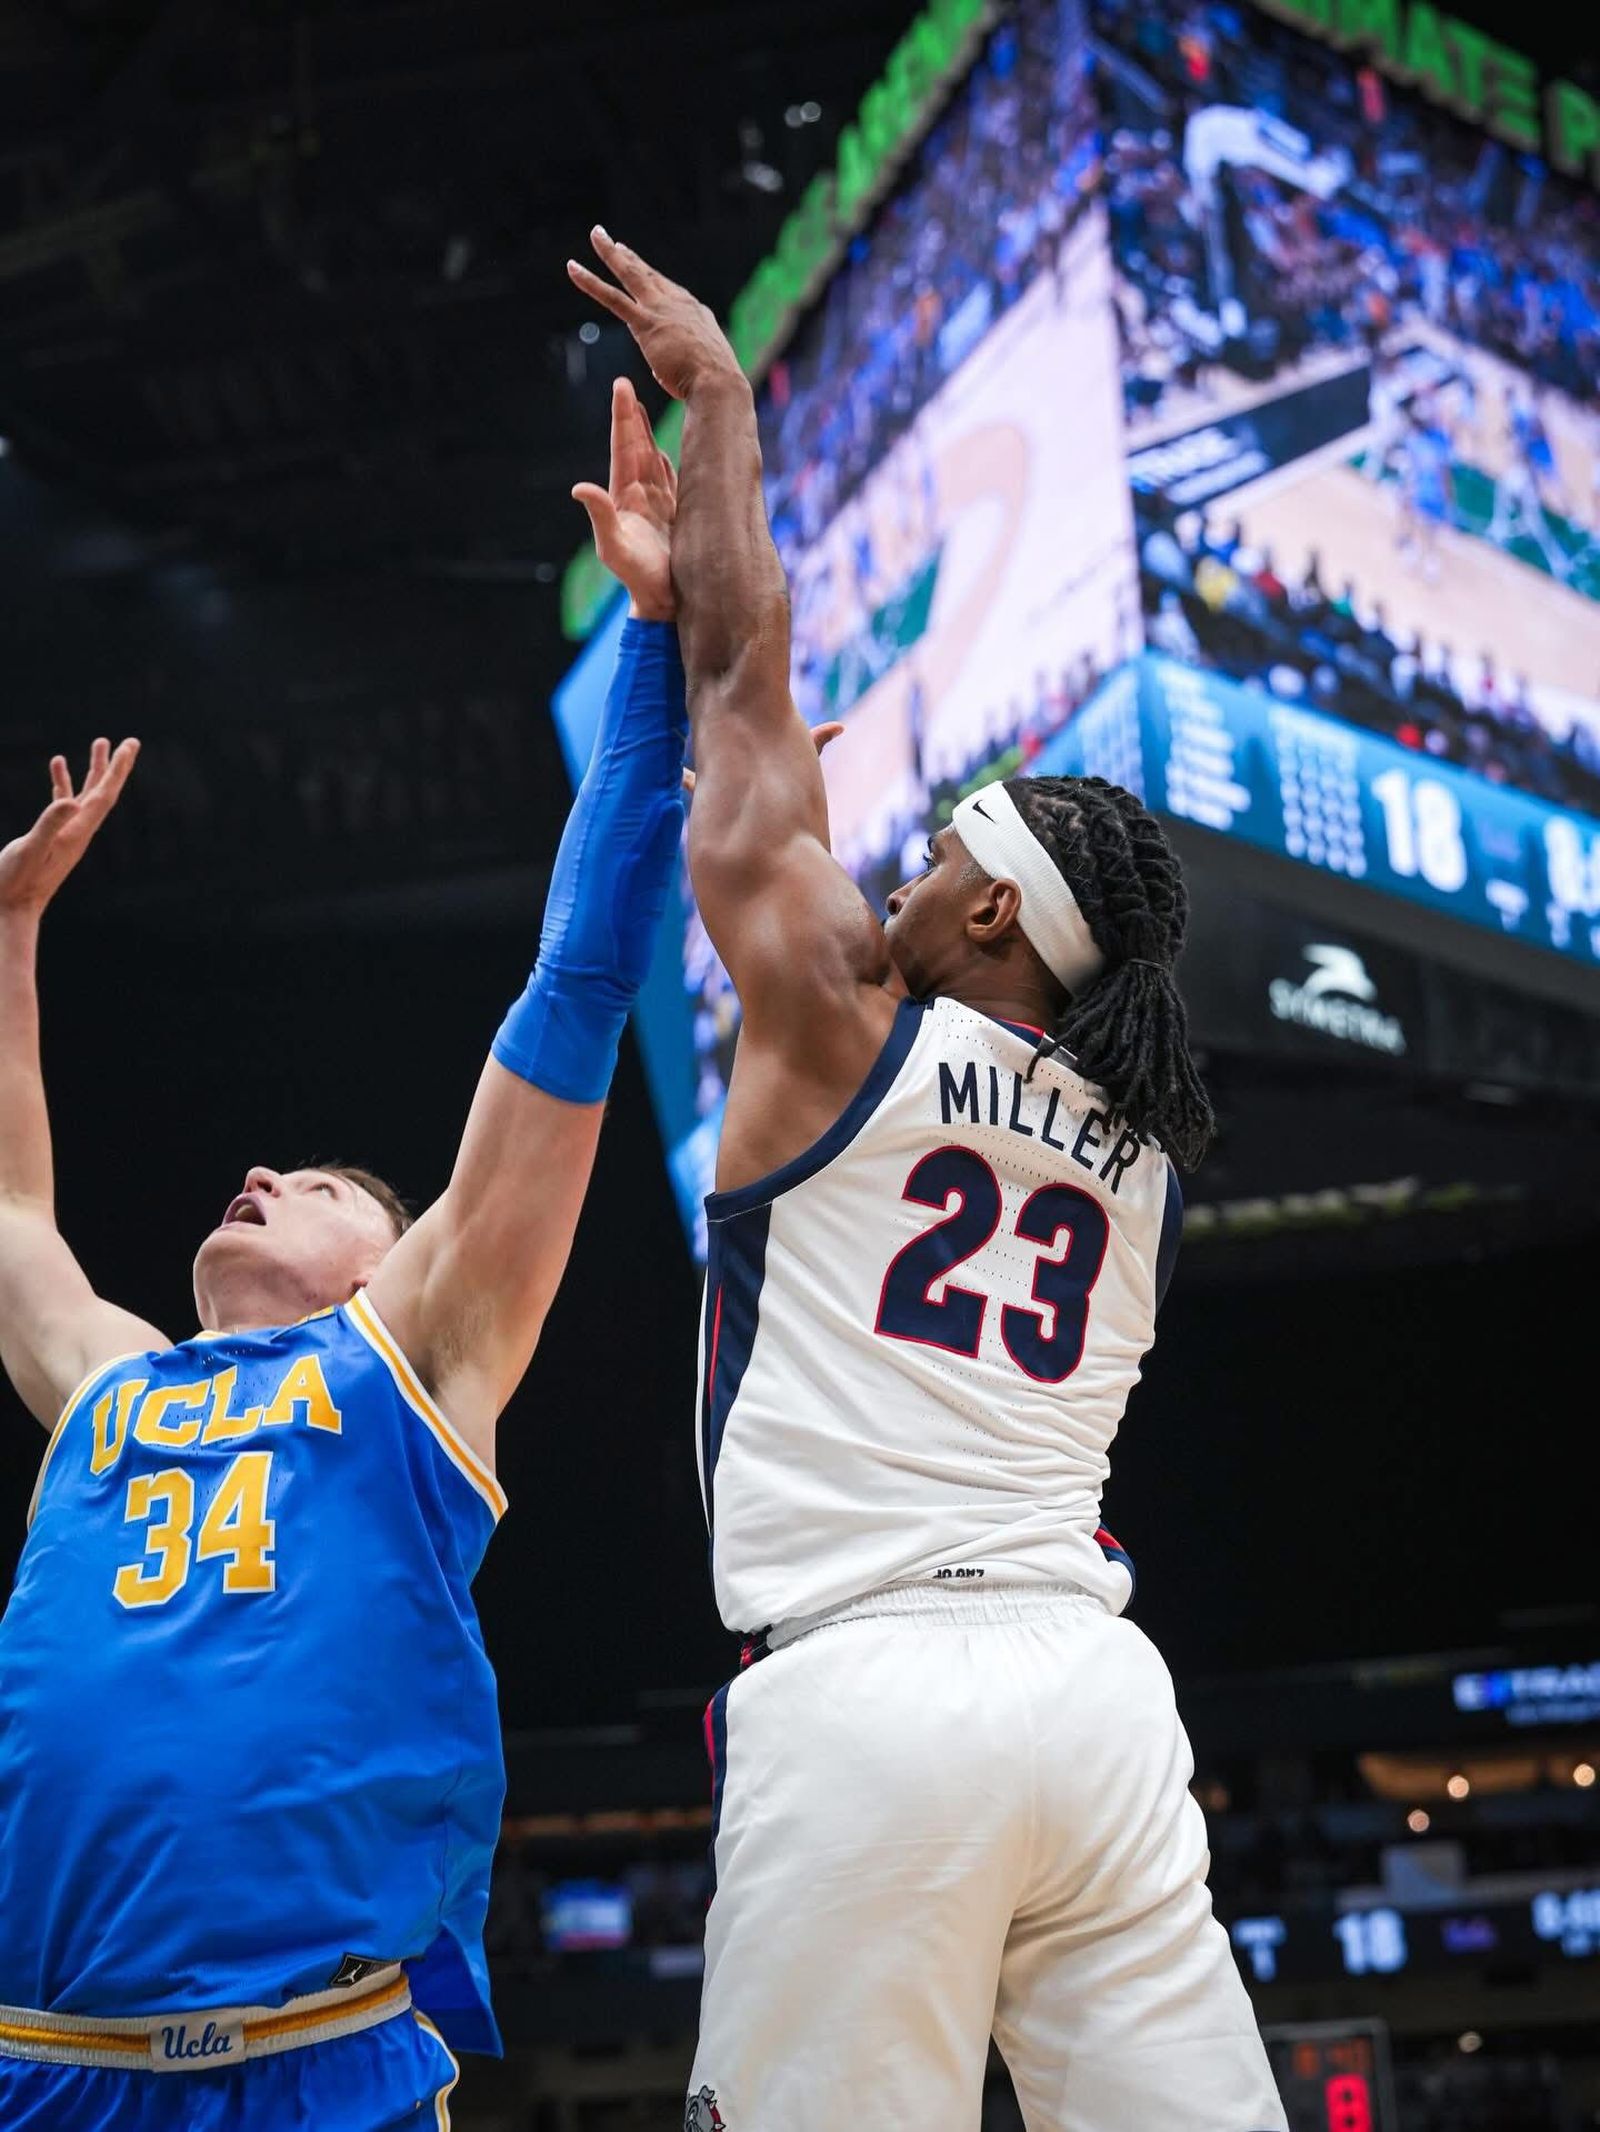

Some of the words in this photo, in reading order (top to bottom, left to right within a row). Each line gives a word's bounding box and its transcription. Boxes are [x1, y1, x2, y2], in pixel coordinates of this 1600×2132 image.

[938, 1061, 1142, 1195] MILLER
[874, 1144, 1109, 1384] 23
[89, 1353, 342, 1475] UCLA
[112, 1450, 276, 1611] 34
[161, 2021, 233, 2059] Ucla
